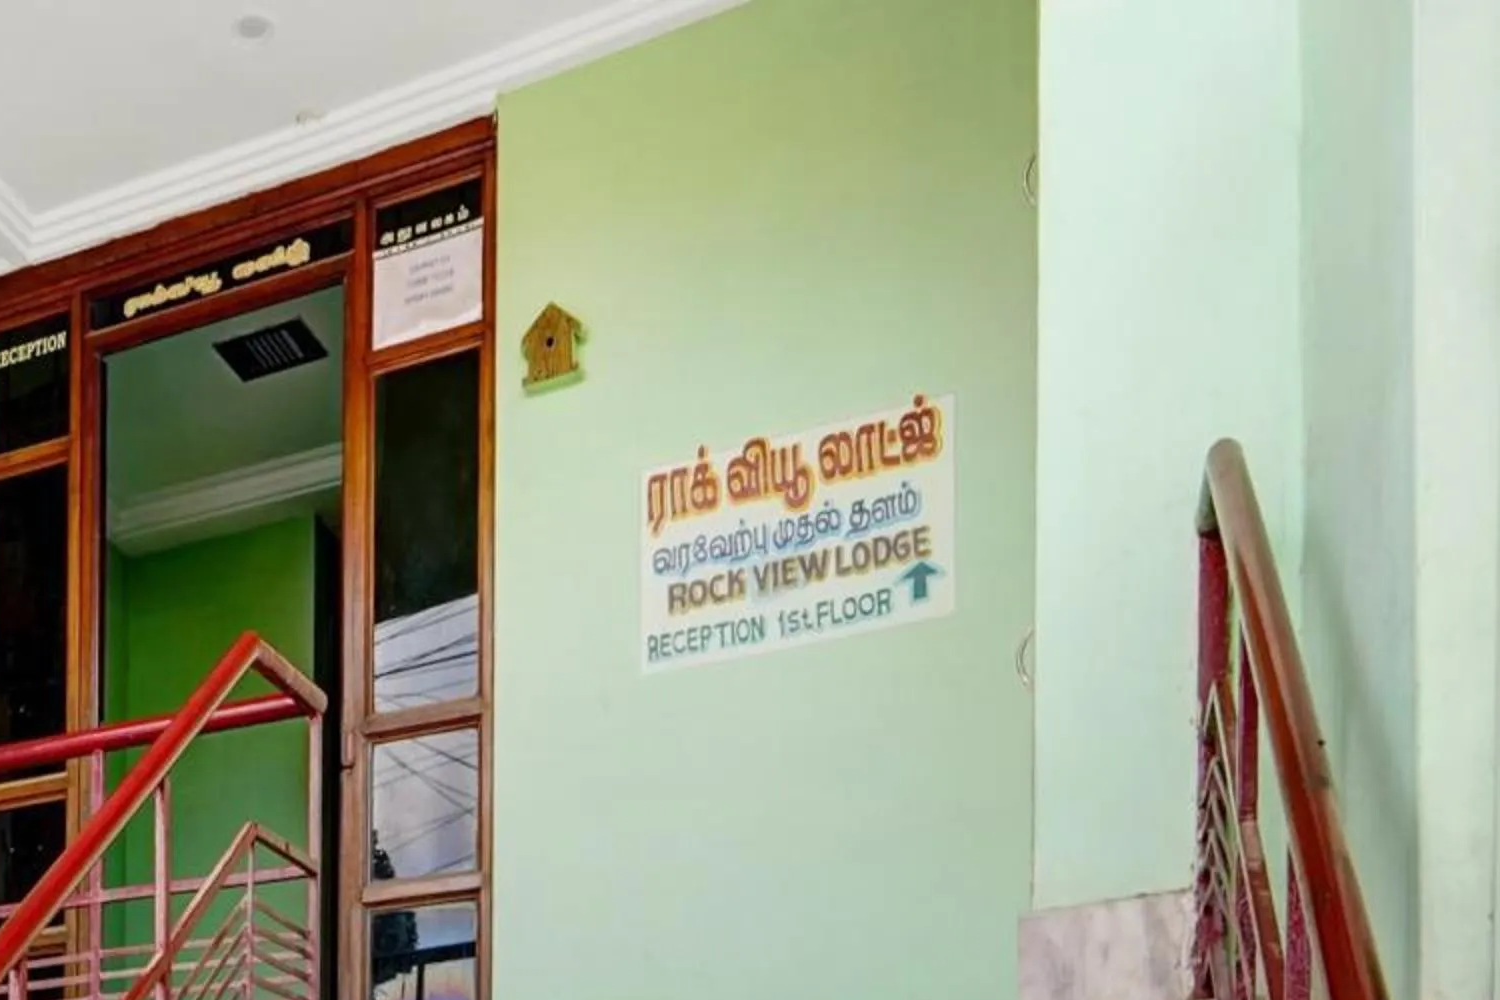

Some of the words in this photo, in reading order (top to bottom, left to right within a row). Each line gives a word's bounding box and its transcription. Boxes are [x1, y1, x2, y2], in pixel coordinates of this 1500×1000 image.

[647, 444, 719, 534] ராக்
[727, 437, 814, 509] வியூ
[819, 394, 940, 478] லாட்ஜ்
[652, 519, 768, 575] வரவேற்பு
[773, 501, 841, 549] முதல்
[846, 483, 919, 537] தளம்
[668, 567, 746, 615] ROCK
[753, 549, 829, 592] VIEW
[834, 526, 933, 576] LODGE
[648, 616, 766, 662] RECEPTION
[816, 588, 892, 628] FLOOR
